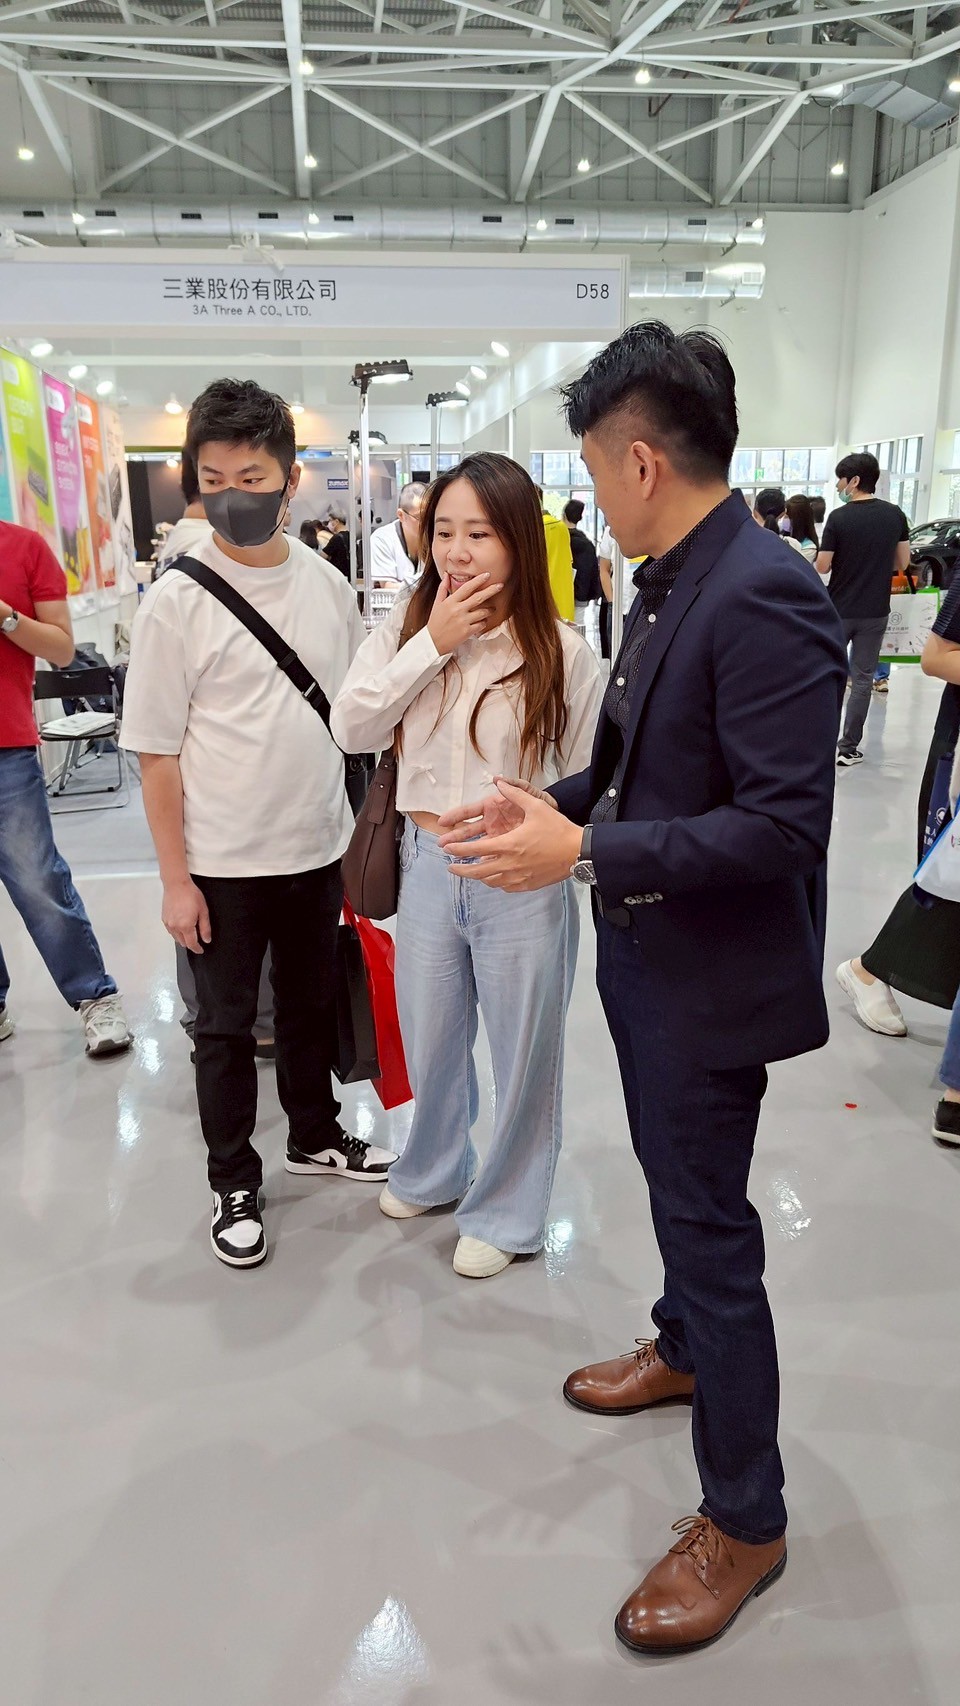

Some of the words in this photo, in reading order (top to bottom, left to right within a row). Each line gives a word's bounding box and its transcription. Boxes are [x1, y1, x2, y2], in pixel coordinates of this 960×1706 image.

[163, 278, 337, 301] 三業股份有限公司
[576, 283, 609, 299] D58
[193, 304, 208, 315] 3A
[213, 304, 243, 315] Three
[247, 305, 256, 315] A
[286, 305, 312, 317] LTD.
